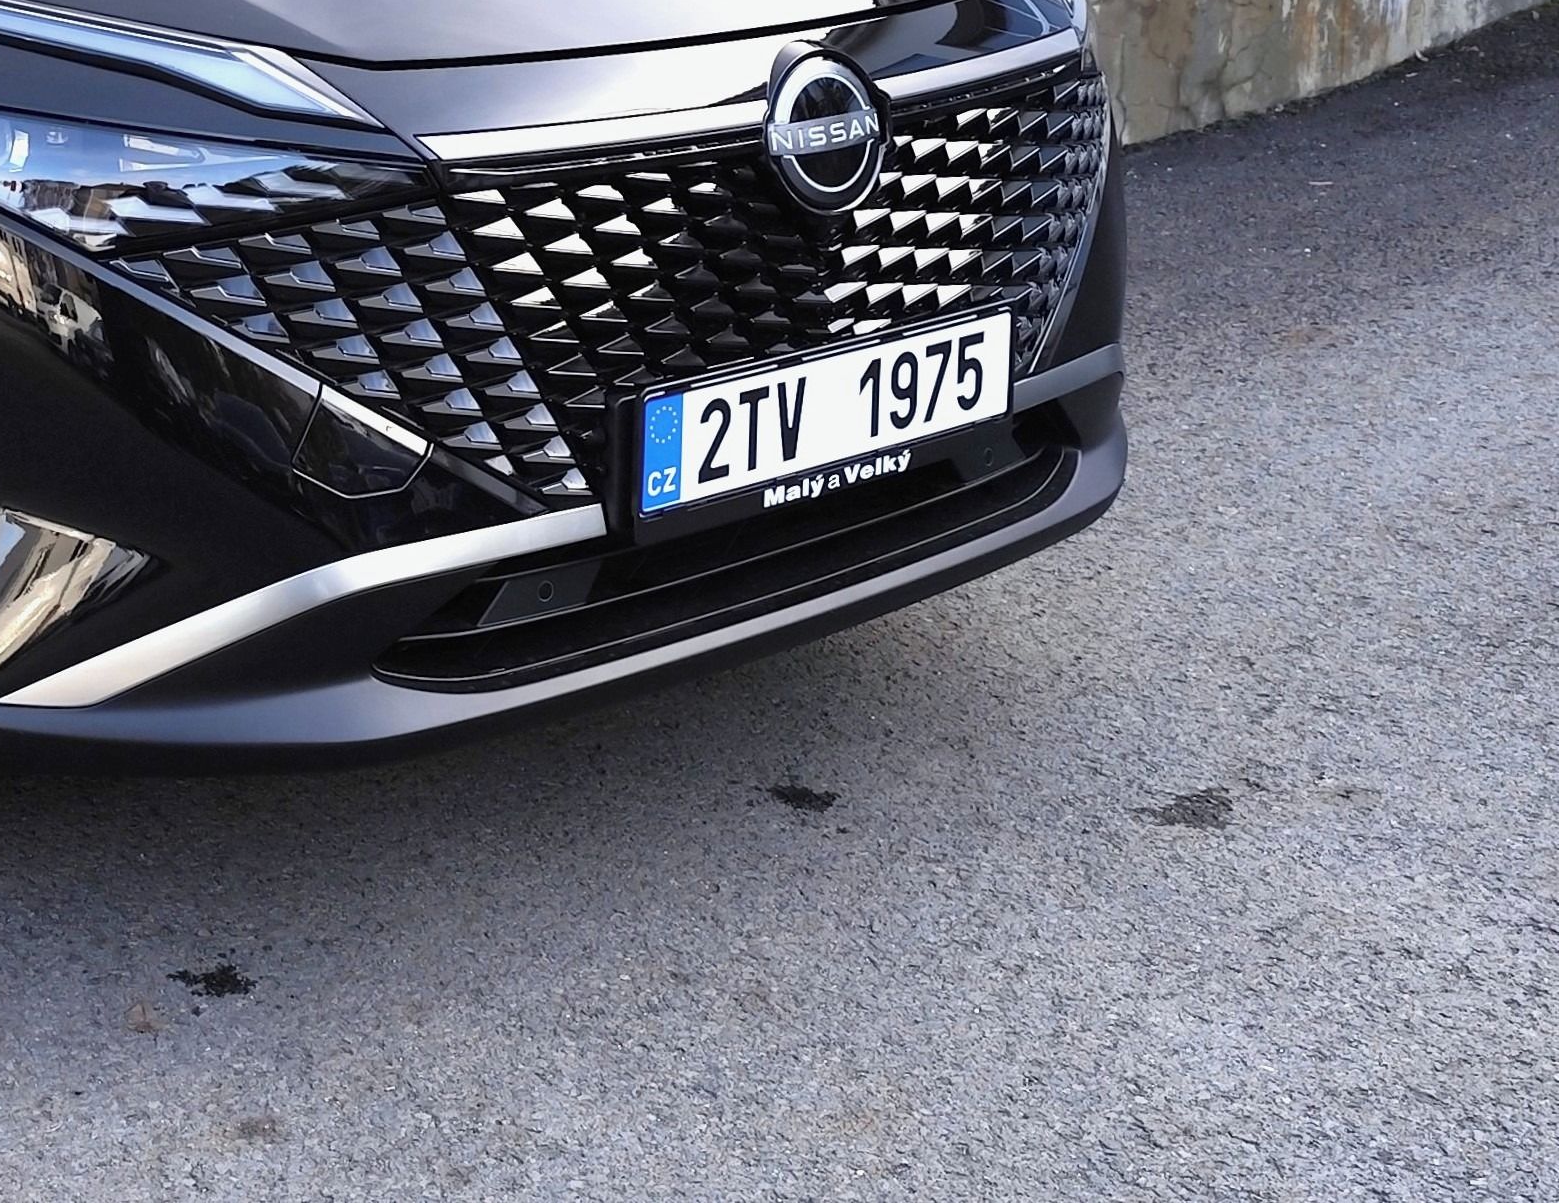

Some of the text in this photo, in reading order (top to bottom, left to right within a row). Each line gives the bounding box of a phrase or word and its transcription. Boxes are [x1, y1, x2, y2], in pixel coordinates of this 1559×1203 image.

[771, 113, 880, 152] NISSAN
[647, 330, 985, 497] CZ 2TV 1975
[763, 448, 912, 508] Malý a Velký
